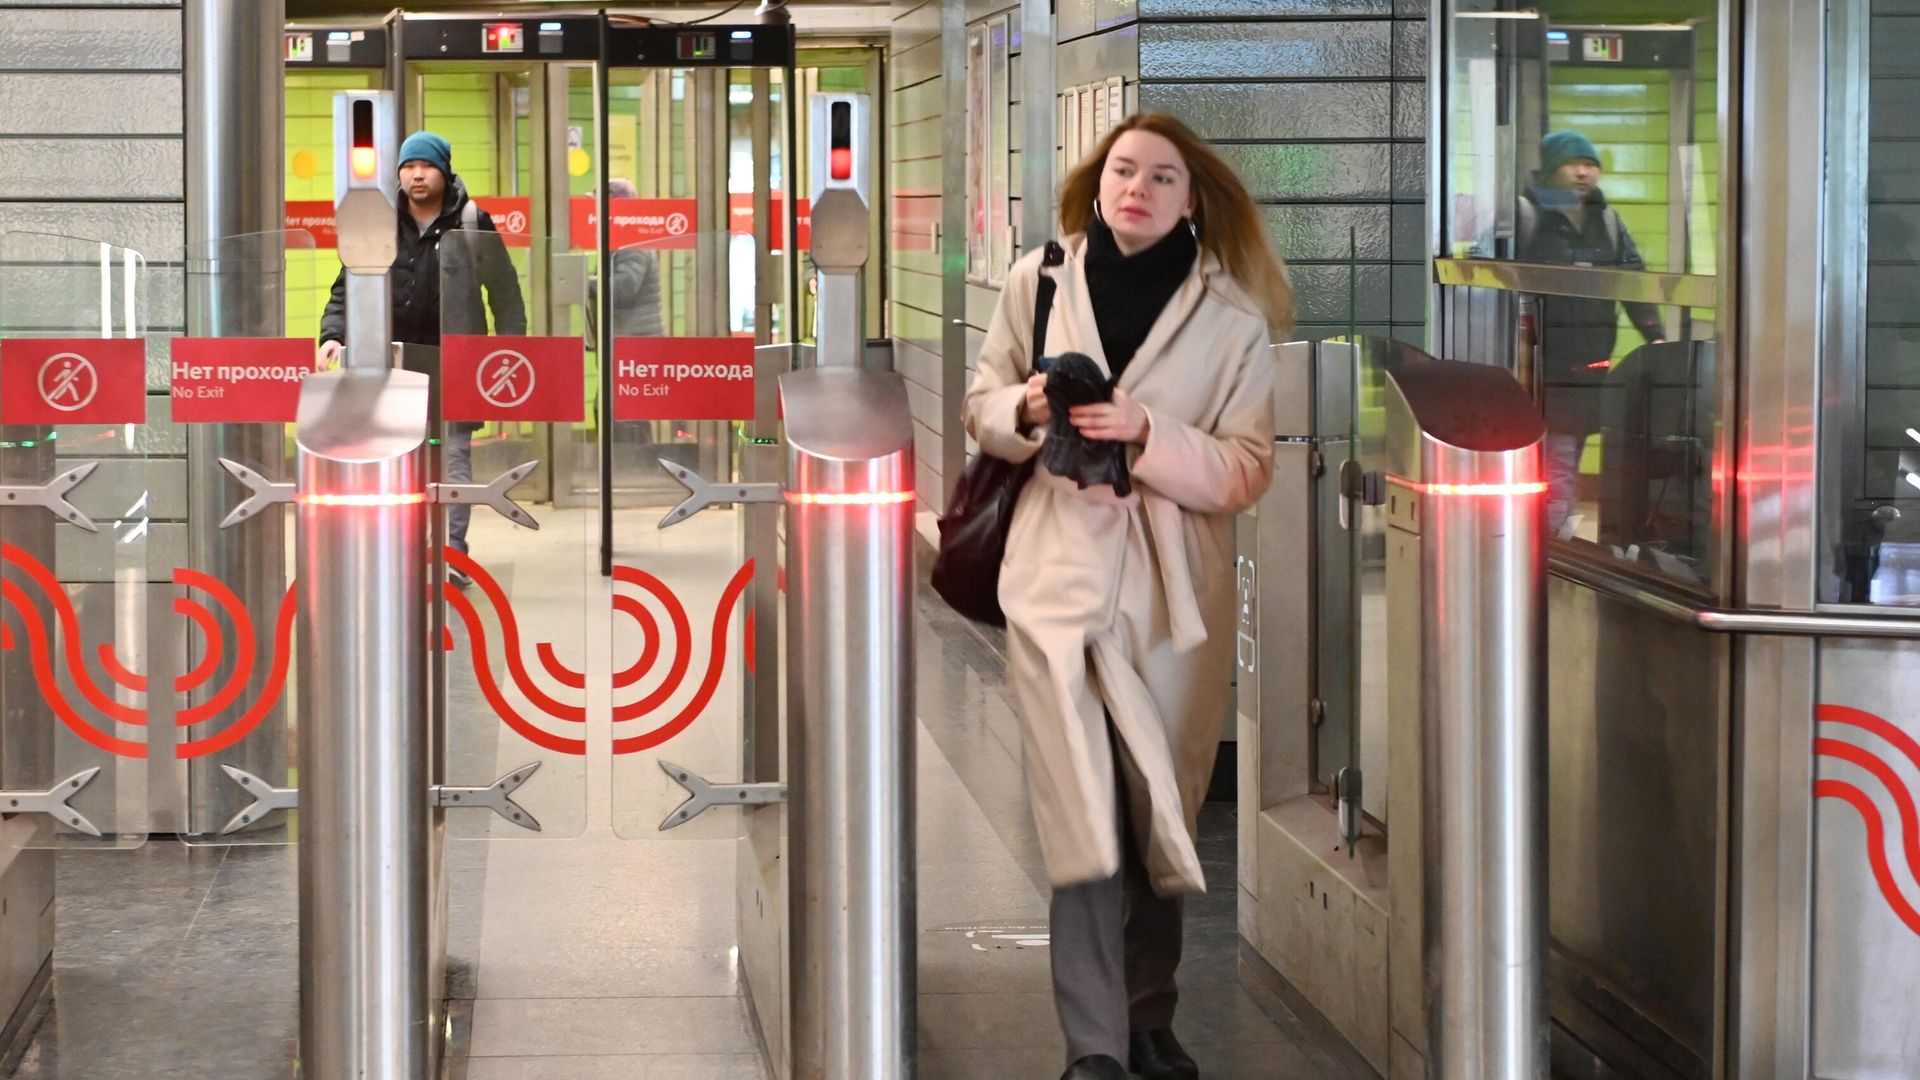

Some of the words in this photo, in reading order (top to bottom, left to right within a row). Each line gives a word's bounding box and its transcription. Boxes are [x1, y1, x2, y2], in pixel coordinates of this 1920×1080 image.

[172, 361, 214, 380] Нет
[619, 360, 659, 378] Нет
[663, 364, 754, 382] прохода
[172, 387, 193, 398] No
[197, 386, 225, 398] Exit
[619, 383, 639, 396] No
[643, 383, 670, 396] Exit
